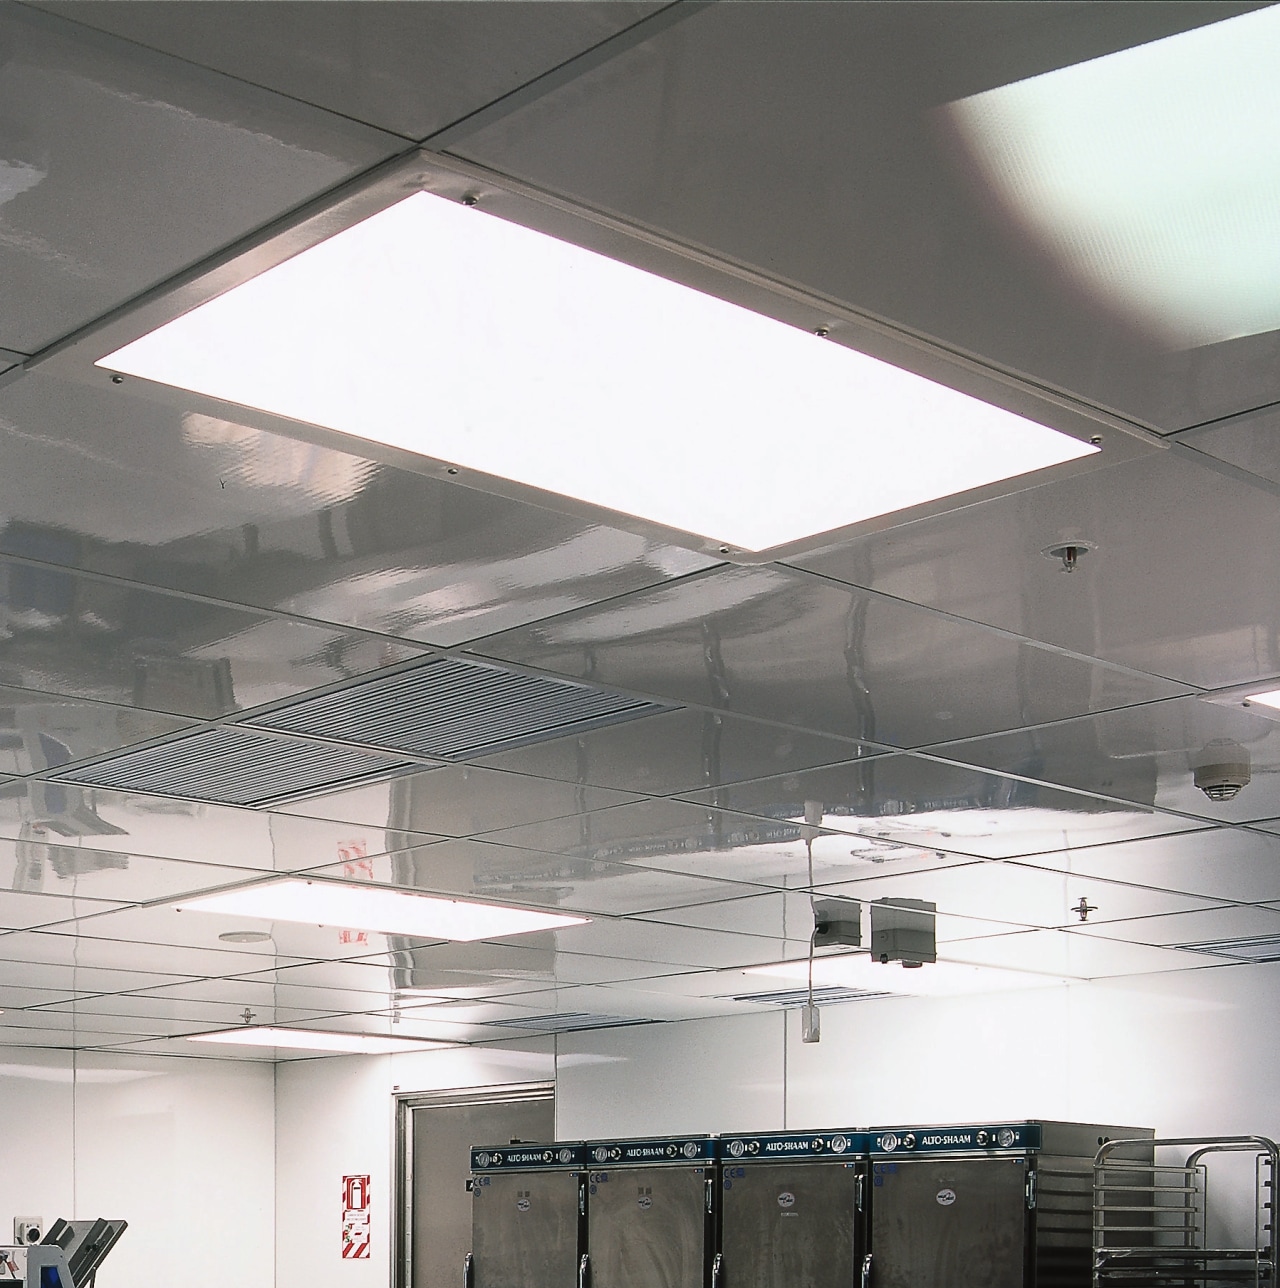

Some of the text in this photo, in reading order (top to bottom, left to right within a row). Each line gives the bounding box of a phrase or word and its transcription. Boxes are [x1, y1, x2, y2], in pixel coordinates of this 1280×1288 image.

[922, 1135, 971, 1145] ALTO-SHAAM
[765, 1141, 809, 1151] ALTO-SHAAM
[626, 1147, 664, 1157] ALTO-SHAAM
